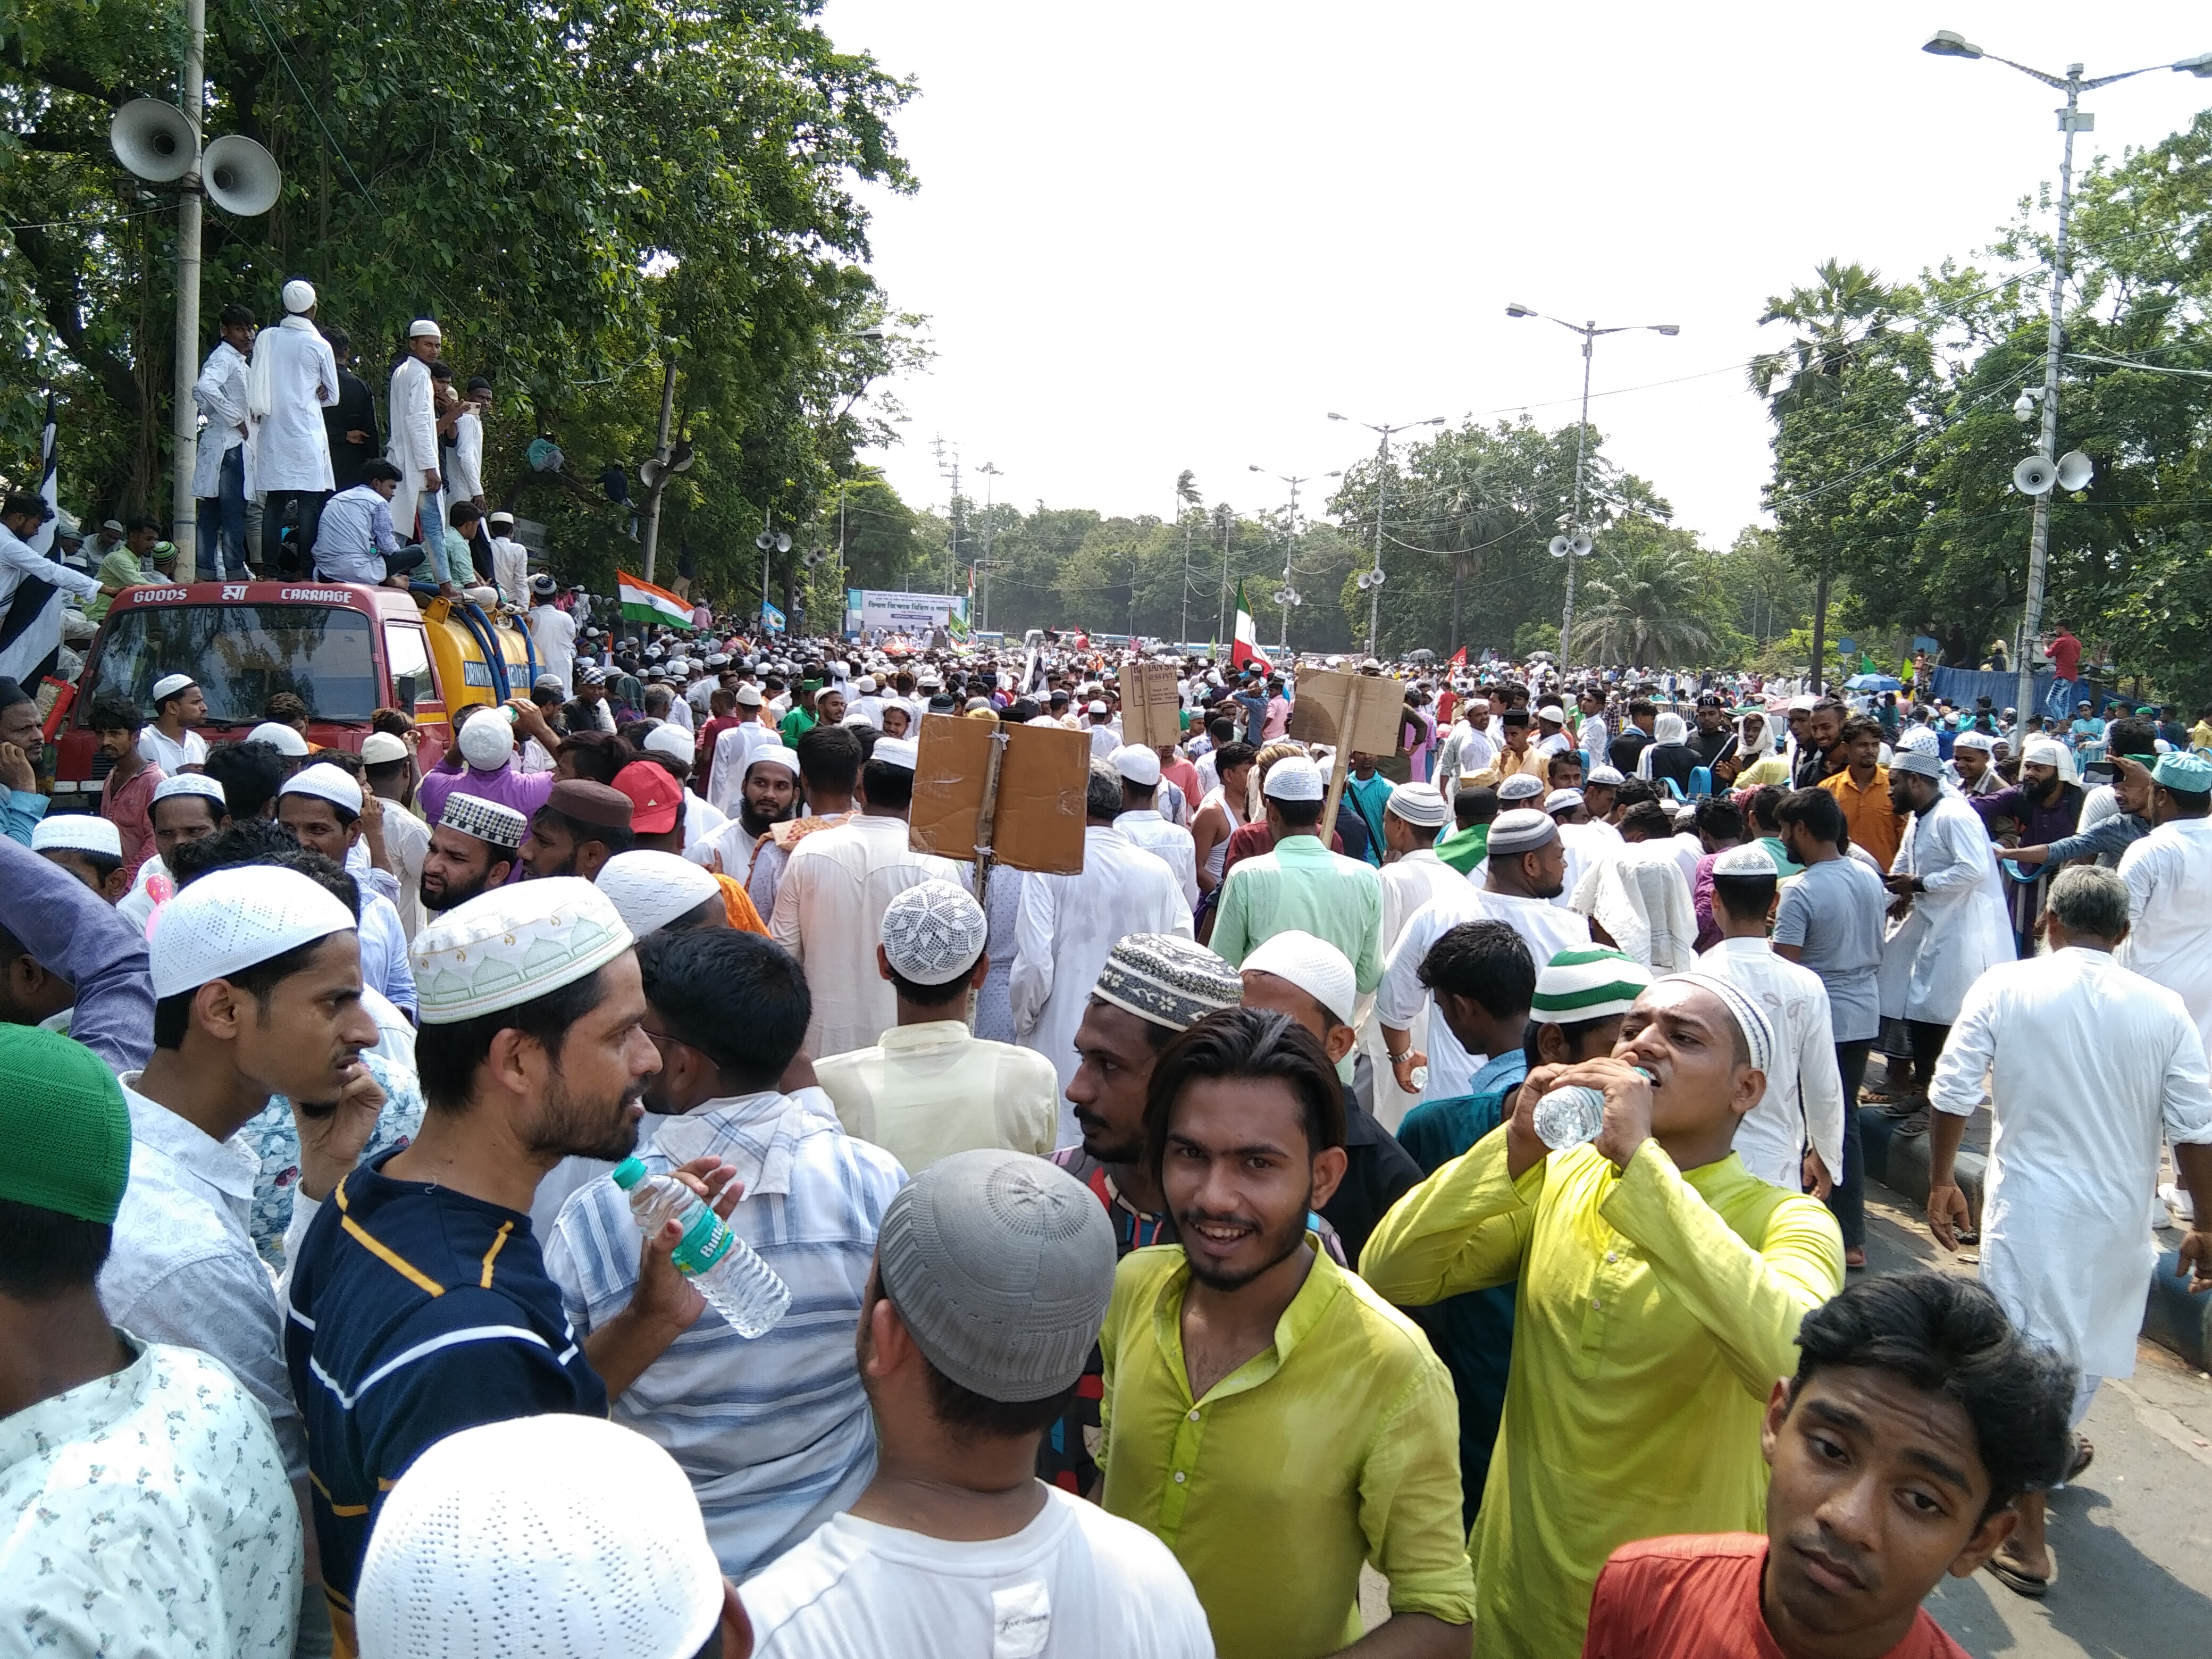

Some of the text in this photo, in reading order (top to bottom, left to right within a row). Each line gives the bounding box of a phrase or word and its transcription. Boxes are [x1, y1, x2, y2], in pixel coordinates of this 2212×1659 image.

[133, 588, 188, 604] GOODS
[221, 585, 249, 601] মা
[280, 588, 353, 604] CARRIAGE
[465, 662, 493, 686] DRINKIN
